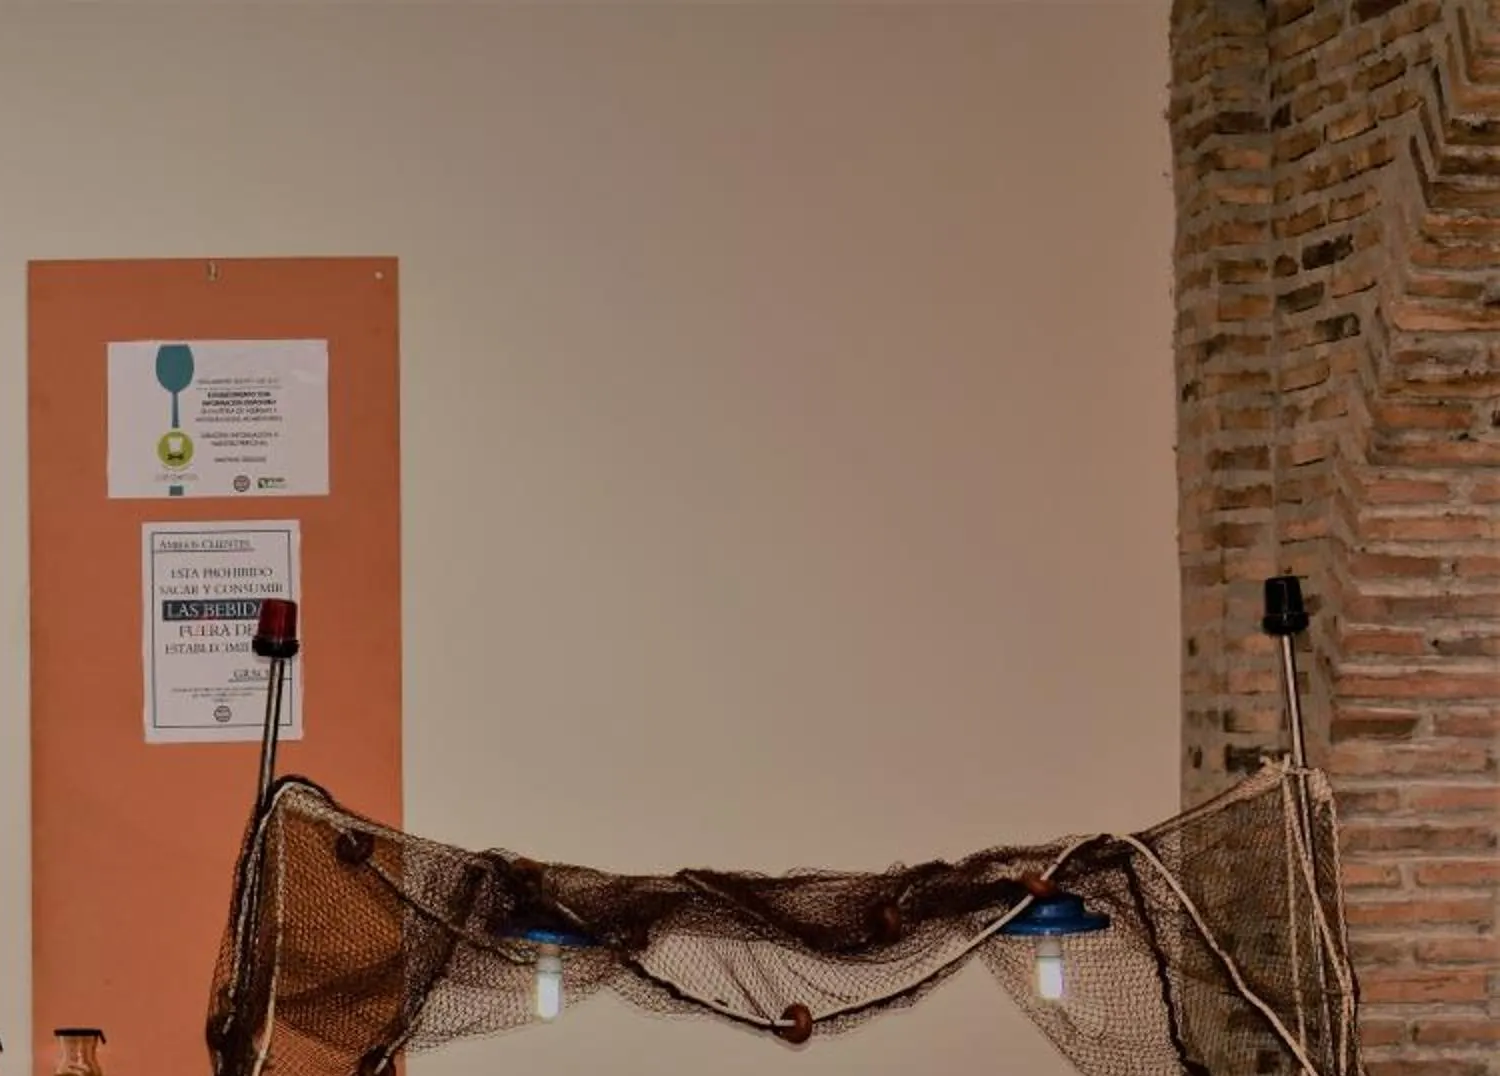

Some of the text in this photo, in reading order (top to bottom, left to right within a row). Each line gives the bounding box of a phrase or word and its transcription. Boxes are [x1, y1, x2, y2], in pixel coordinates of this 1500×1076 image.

[203, 567, 274, 578] PROHIBIDO
[202, 584, 212, 595] Y
[167, 601, 263, 618] LAS BEBID
